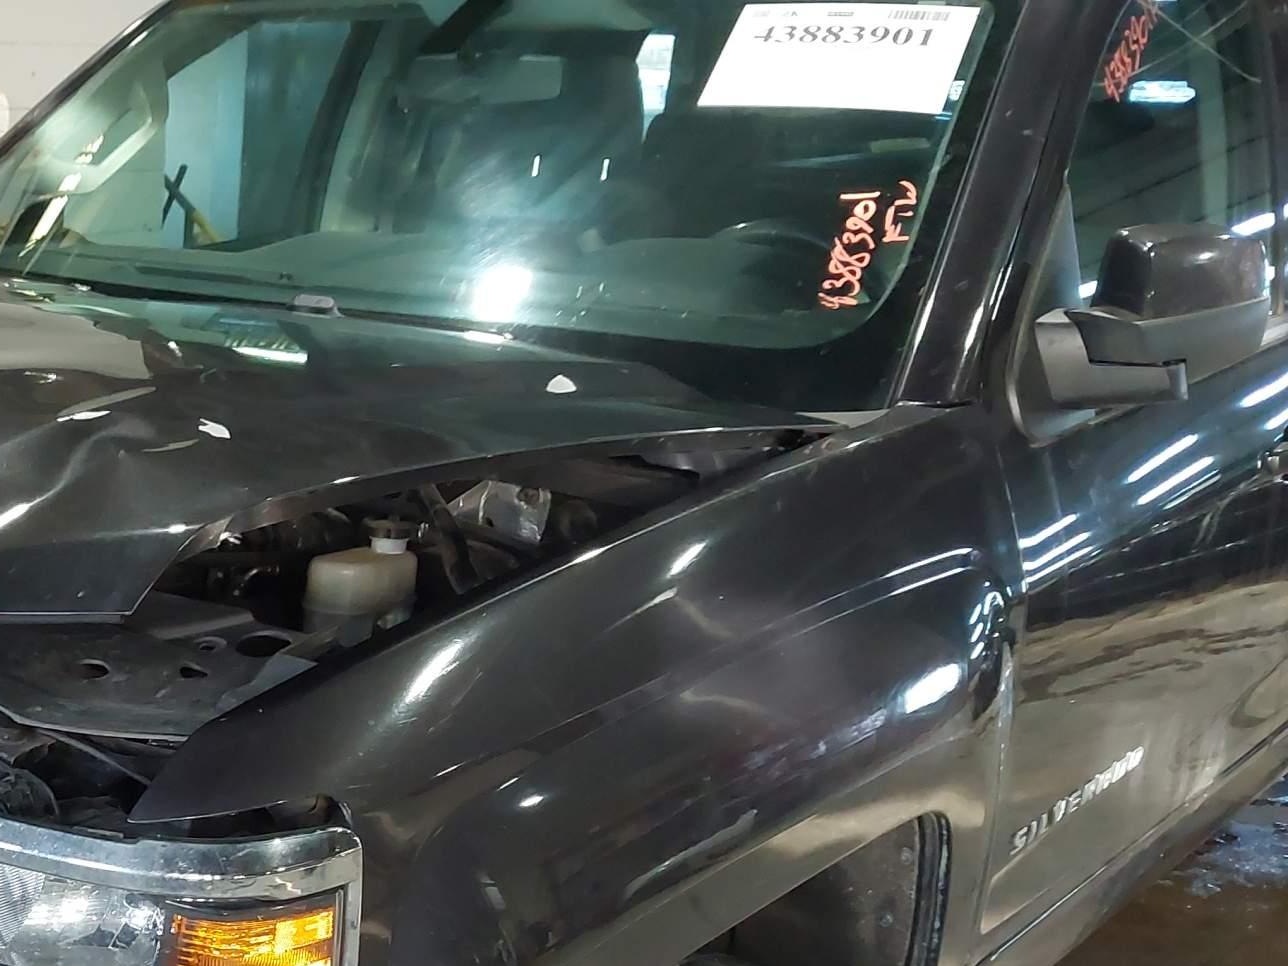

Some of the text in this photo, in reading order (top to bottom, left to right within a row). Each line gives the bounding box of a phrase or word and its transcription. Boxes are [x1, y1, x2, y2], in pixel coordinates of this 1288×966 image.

[754, 26, 933, 46] 43883901
[817, 191, 881, 310] 43883901
[1010, 746, 1145, 856] SILVERADO
